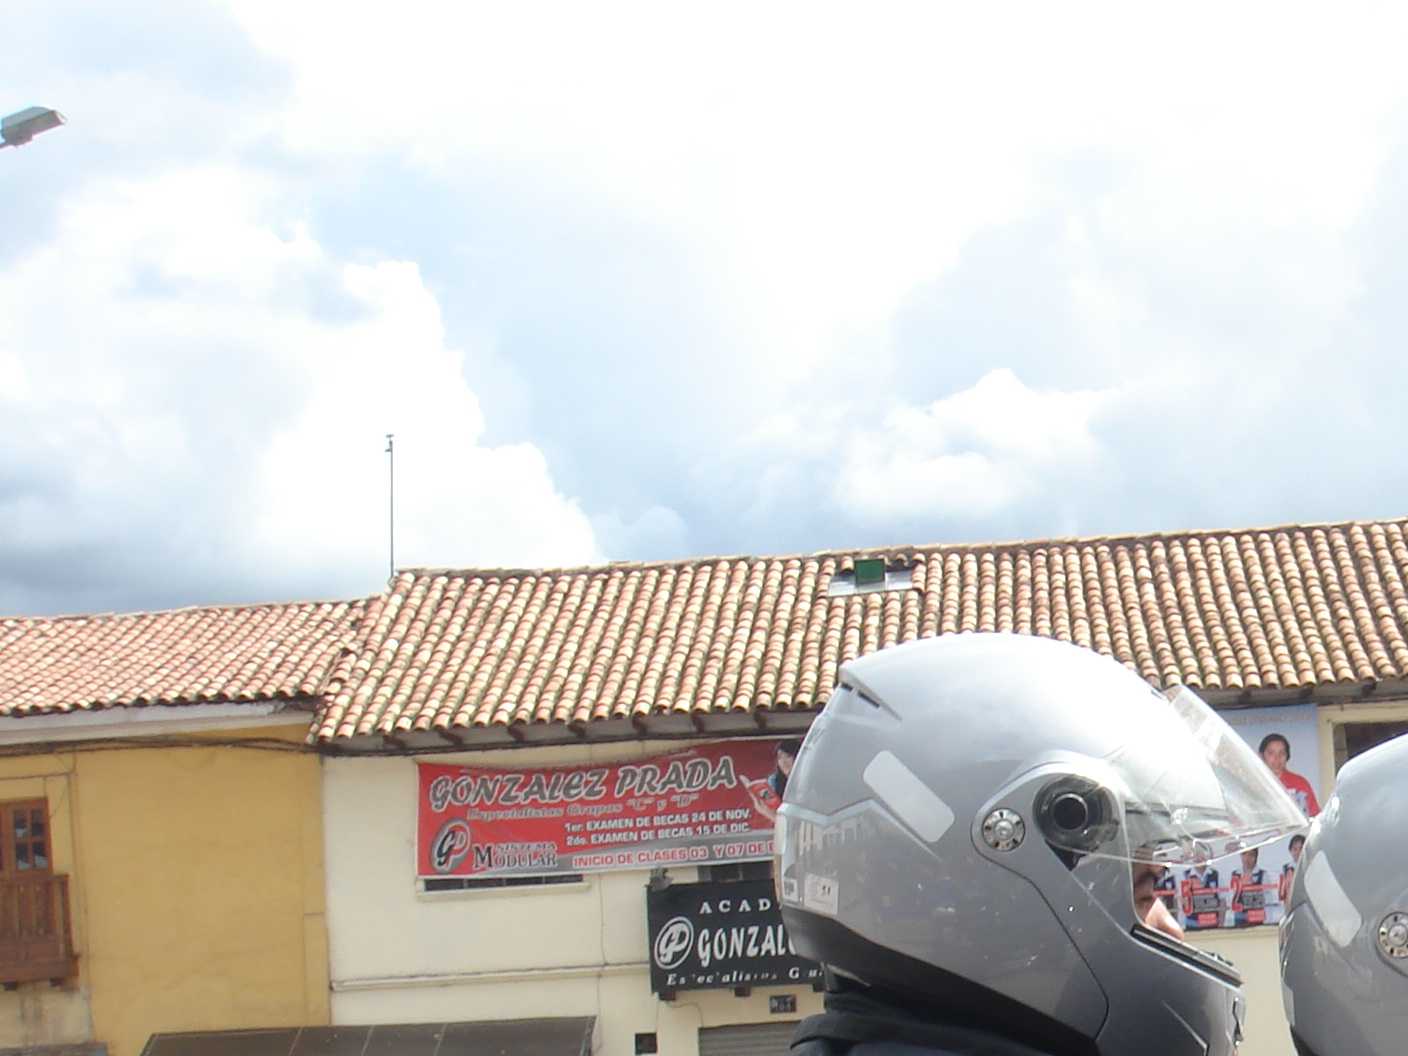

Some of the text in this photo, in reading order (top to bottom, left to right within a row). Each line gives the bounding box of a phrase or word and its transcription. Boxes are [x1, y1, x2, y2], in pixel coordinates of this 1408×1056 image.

[430, 755, 737, 812] GONZALEZ PRADA
[586, 817, 634, 831] EXAMEN
[636, 817, 650, 828] DE
[653, 813, 689, 826] BECAS
[708, 810, 723, 821] DE
[591, 830, 637, 844] EXAMEN
[640, 830, 655, 841] DE
[657, 826, 693, 840] BECAS
[712, 823, 728, 835] DE
[473, 844, 558, 870] MODULAR
[572, 852, 613, 868] INICIO
[616, 851, 634, 864] DE
[637, 848, 687, 863] CLASES
[699, 898, 782, 914] ACAD
